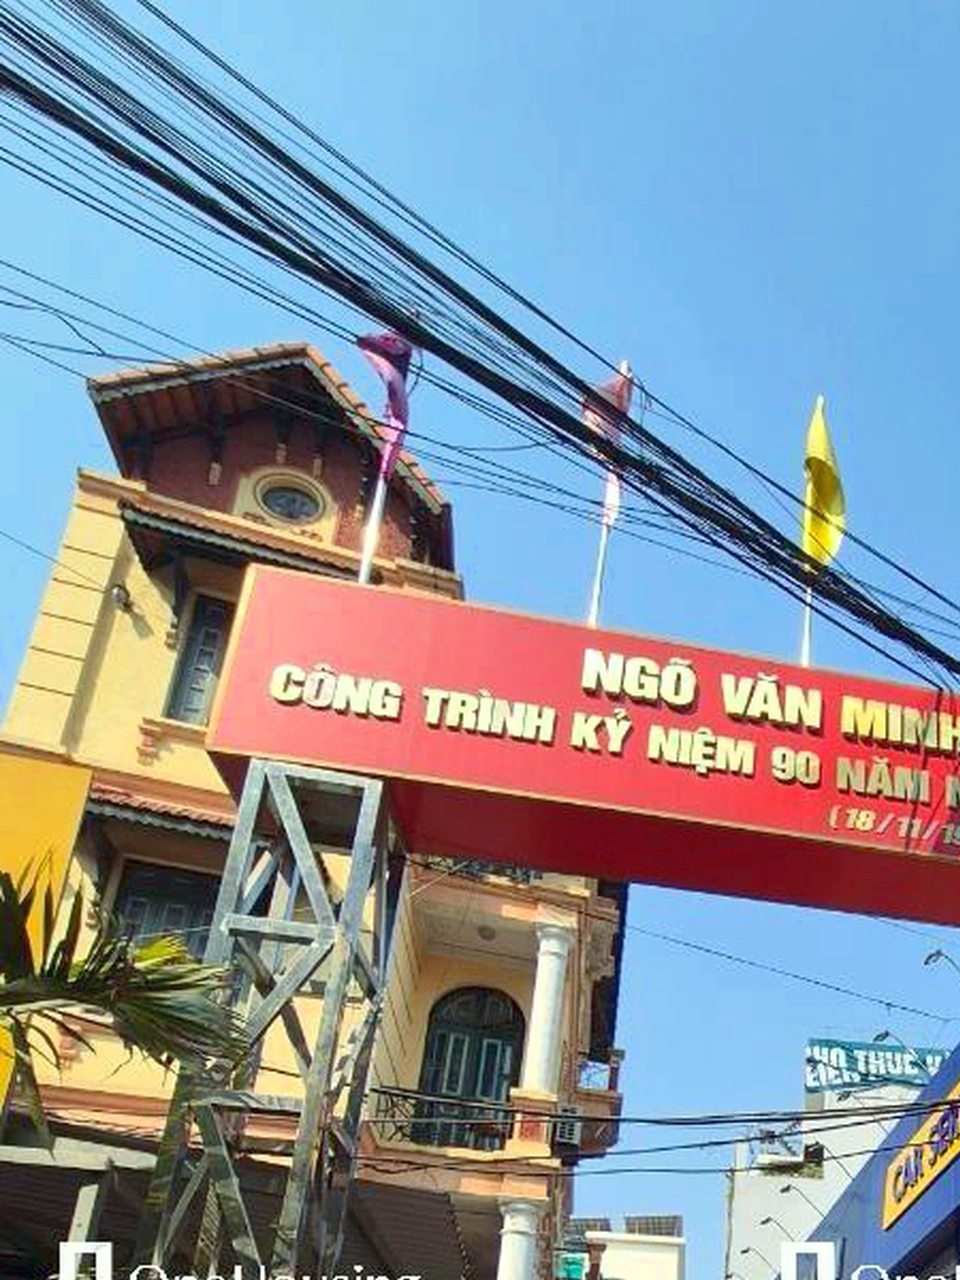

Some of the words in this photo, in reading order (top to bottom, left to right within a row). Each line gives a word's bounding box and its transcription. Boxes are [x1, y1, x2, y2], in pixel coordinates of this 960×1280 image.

[270, 663, 403, 720] CÔNG
[422, 688, 557, 744] TRÌNH
[570, 708, 632, 755] KỶ
[648, 727, 756, 776] NIỆM
[771, 746, 821, 786] 90
[836, 755, 930, 805] NĂM
[582, 648, 698, 709] NGÕ
[721, 672, 823, 730] VĂN
